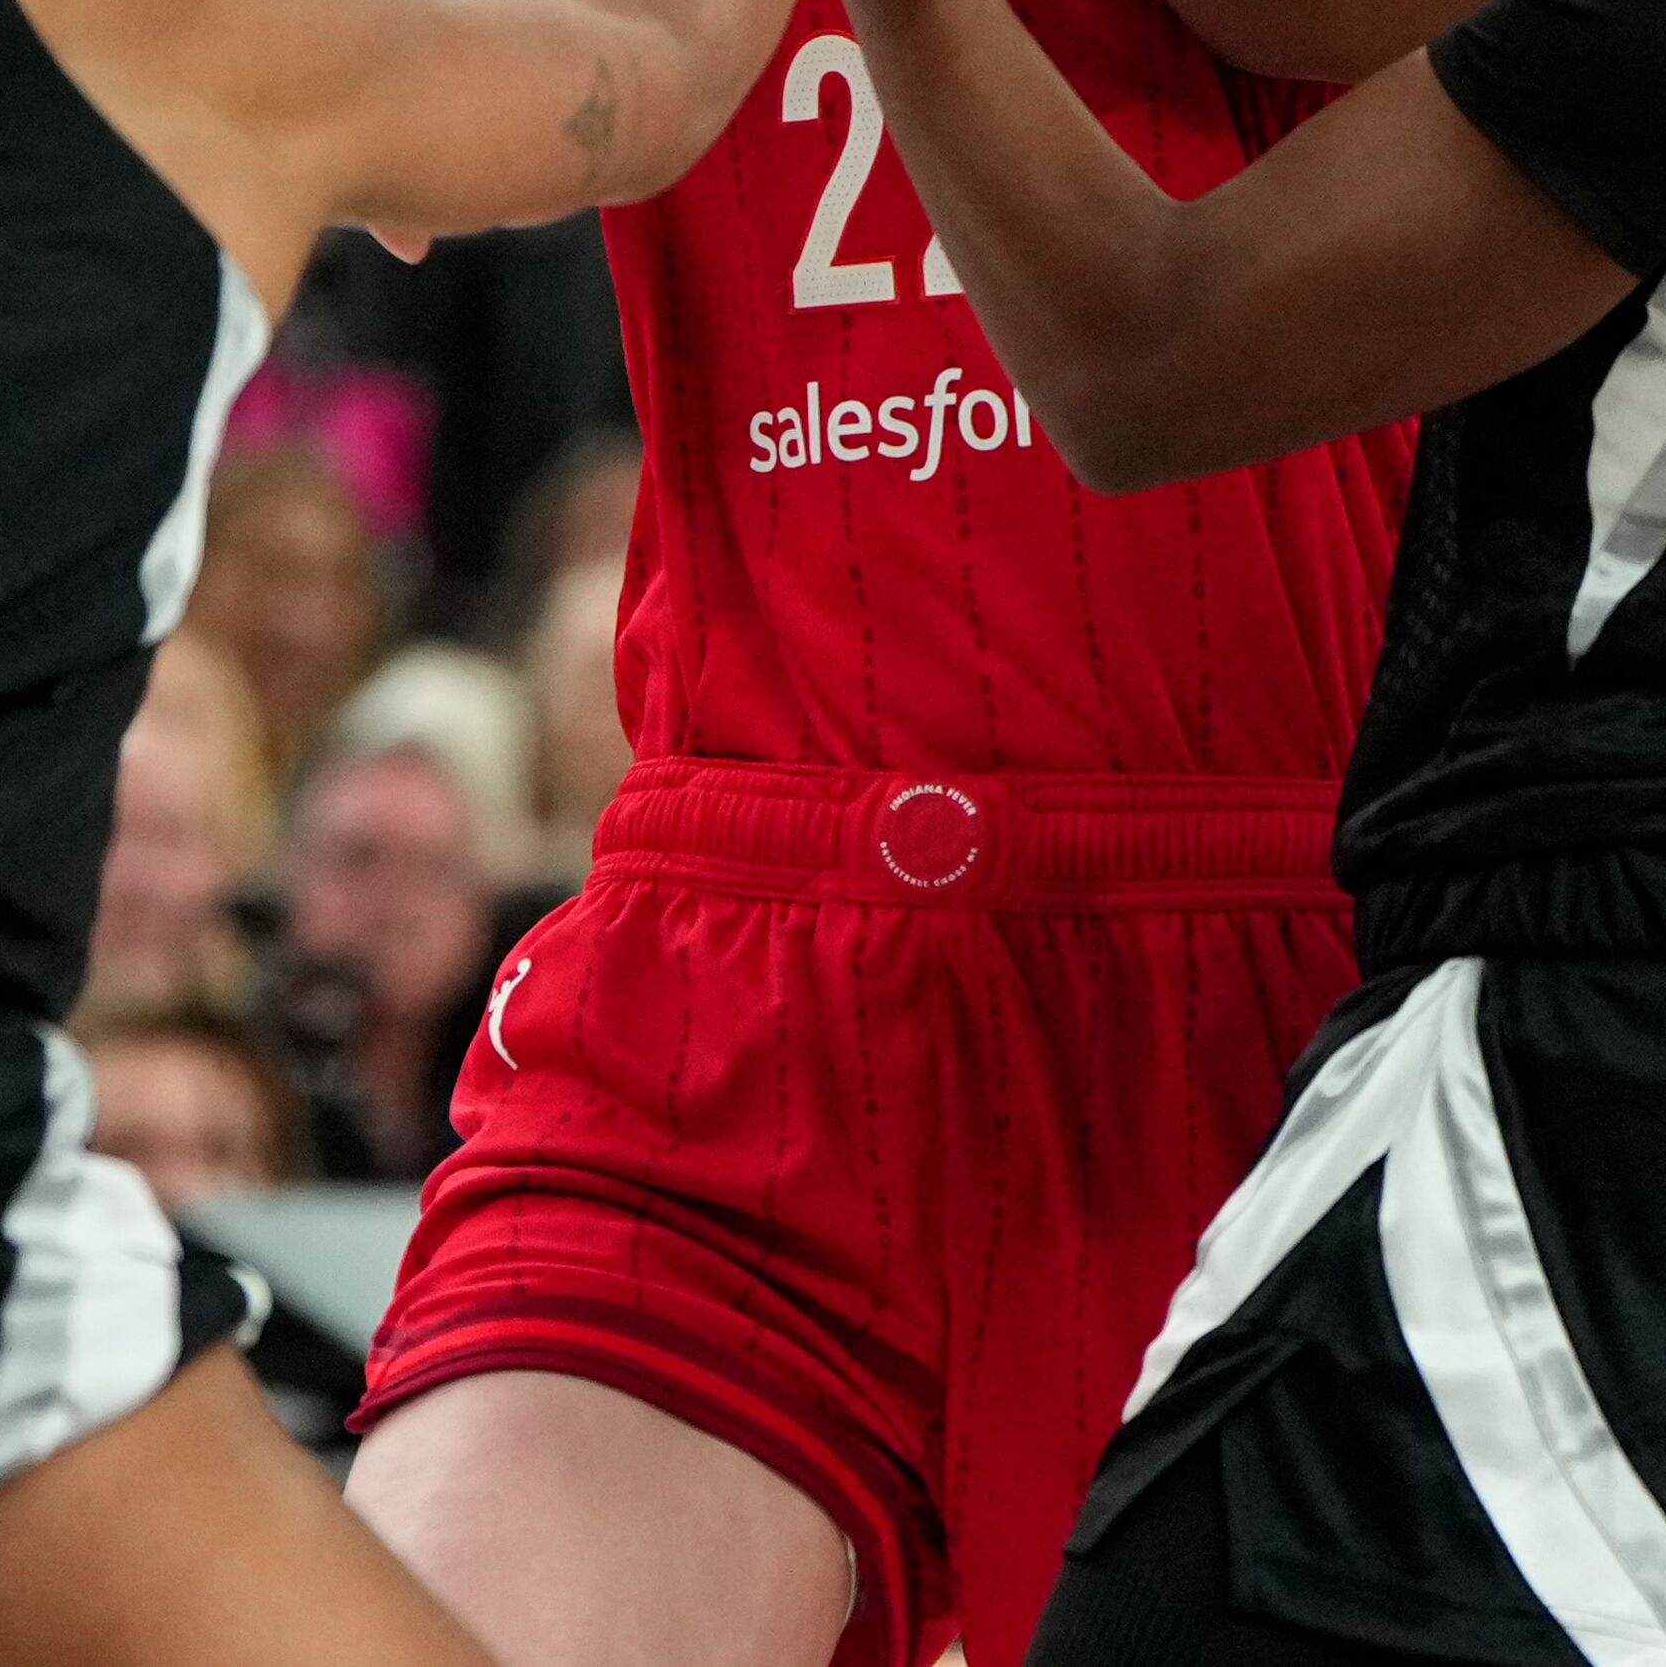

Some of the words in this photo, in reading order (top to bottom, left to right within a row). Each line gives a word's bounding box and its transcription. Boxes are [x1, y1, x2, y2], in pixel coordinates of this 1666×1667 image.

[782, 34, 963, 309] 2
[889, 784, 943, 812] INDIANA
[946, 787, 978, 817] FEVER
[879, 841, 930, 888] BASKETBALL
